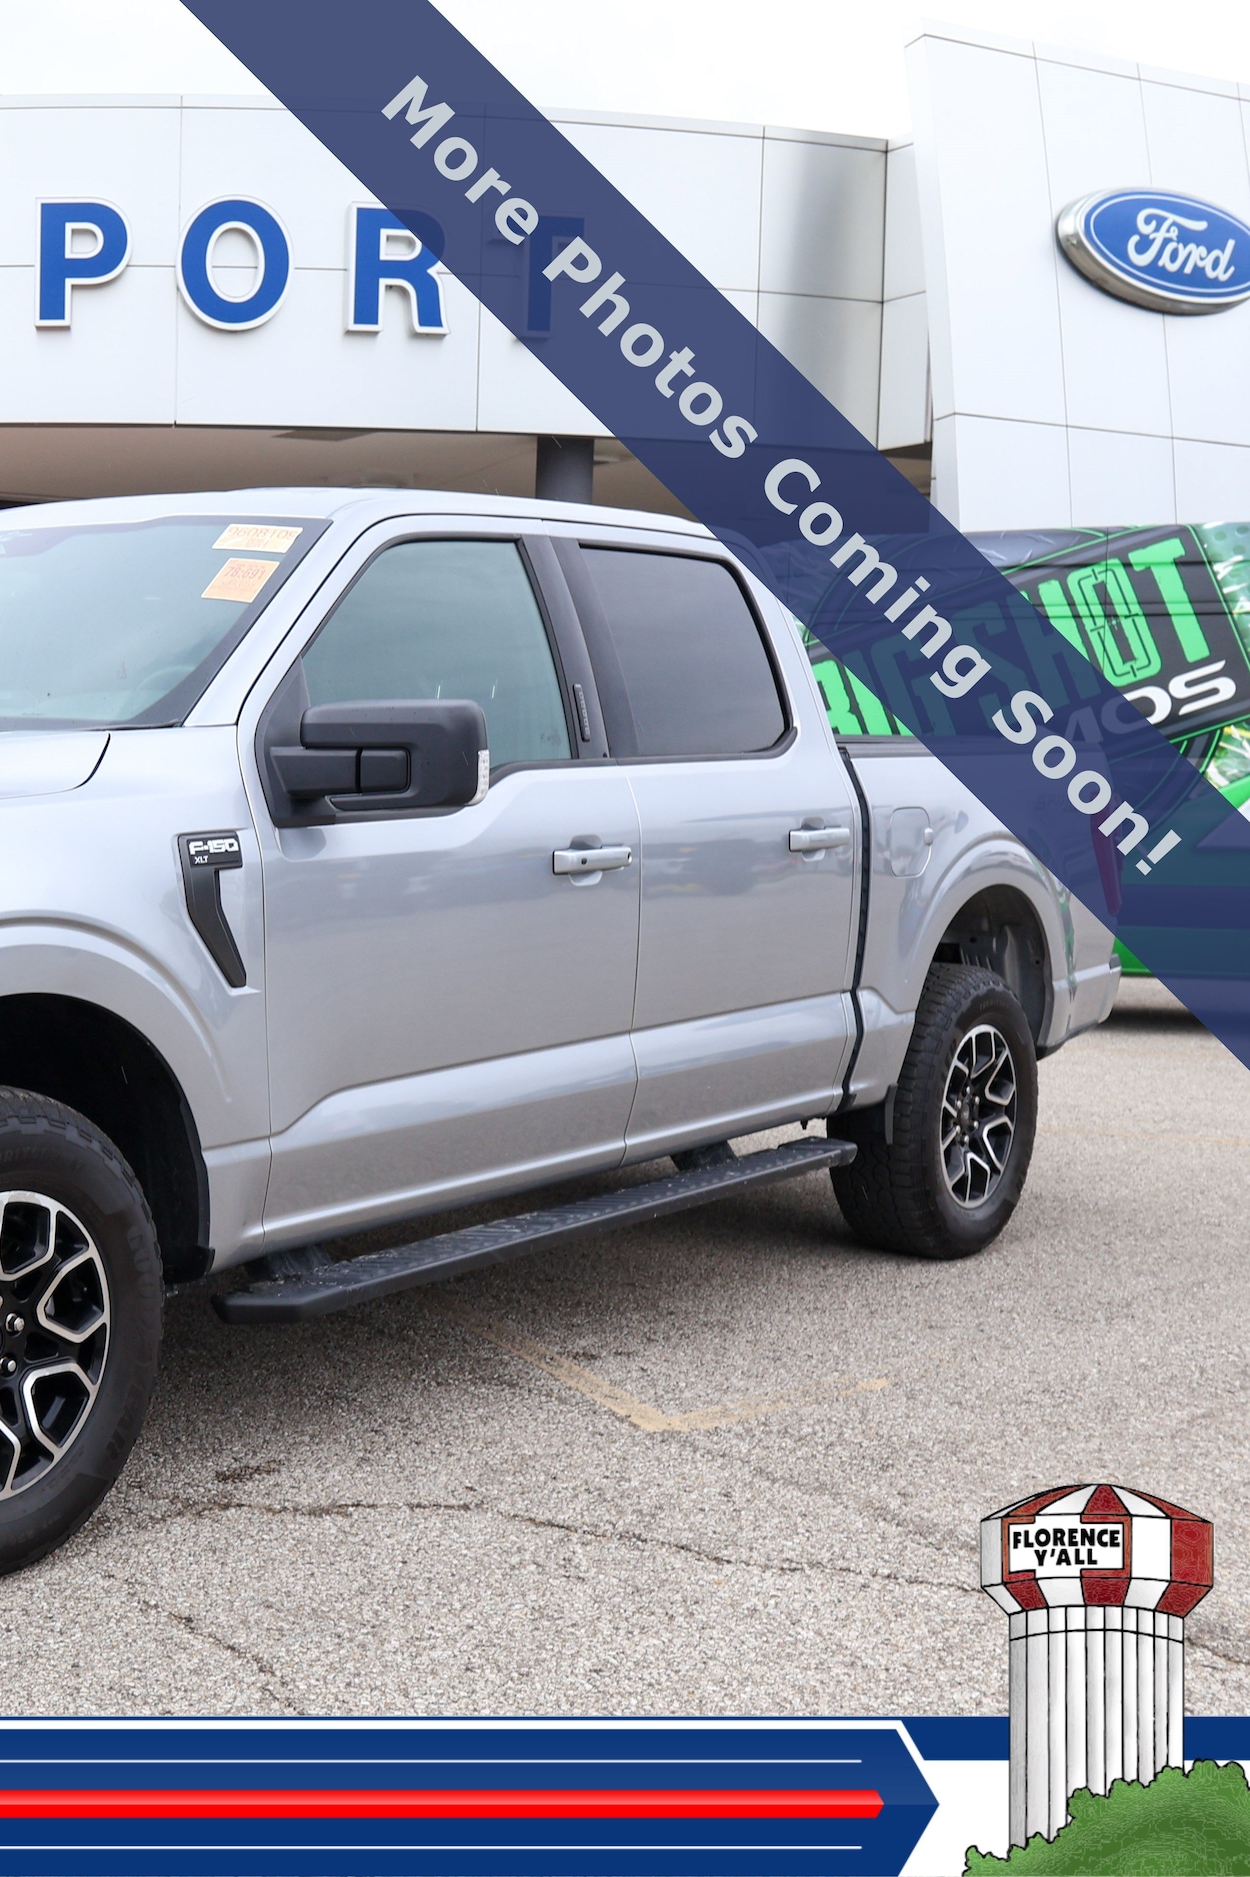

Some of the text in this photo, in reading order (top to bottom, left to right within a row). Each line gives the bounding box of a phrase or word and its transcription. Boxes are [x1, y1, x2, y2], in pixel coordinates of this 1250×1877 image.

[1127, 207, 1236, 282] Ford
[188, 838, 238, 855] F-150
[194, 856, 208, 864] XLT
